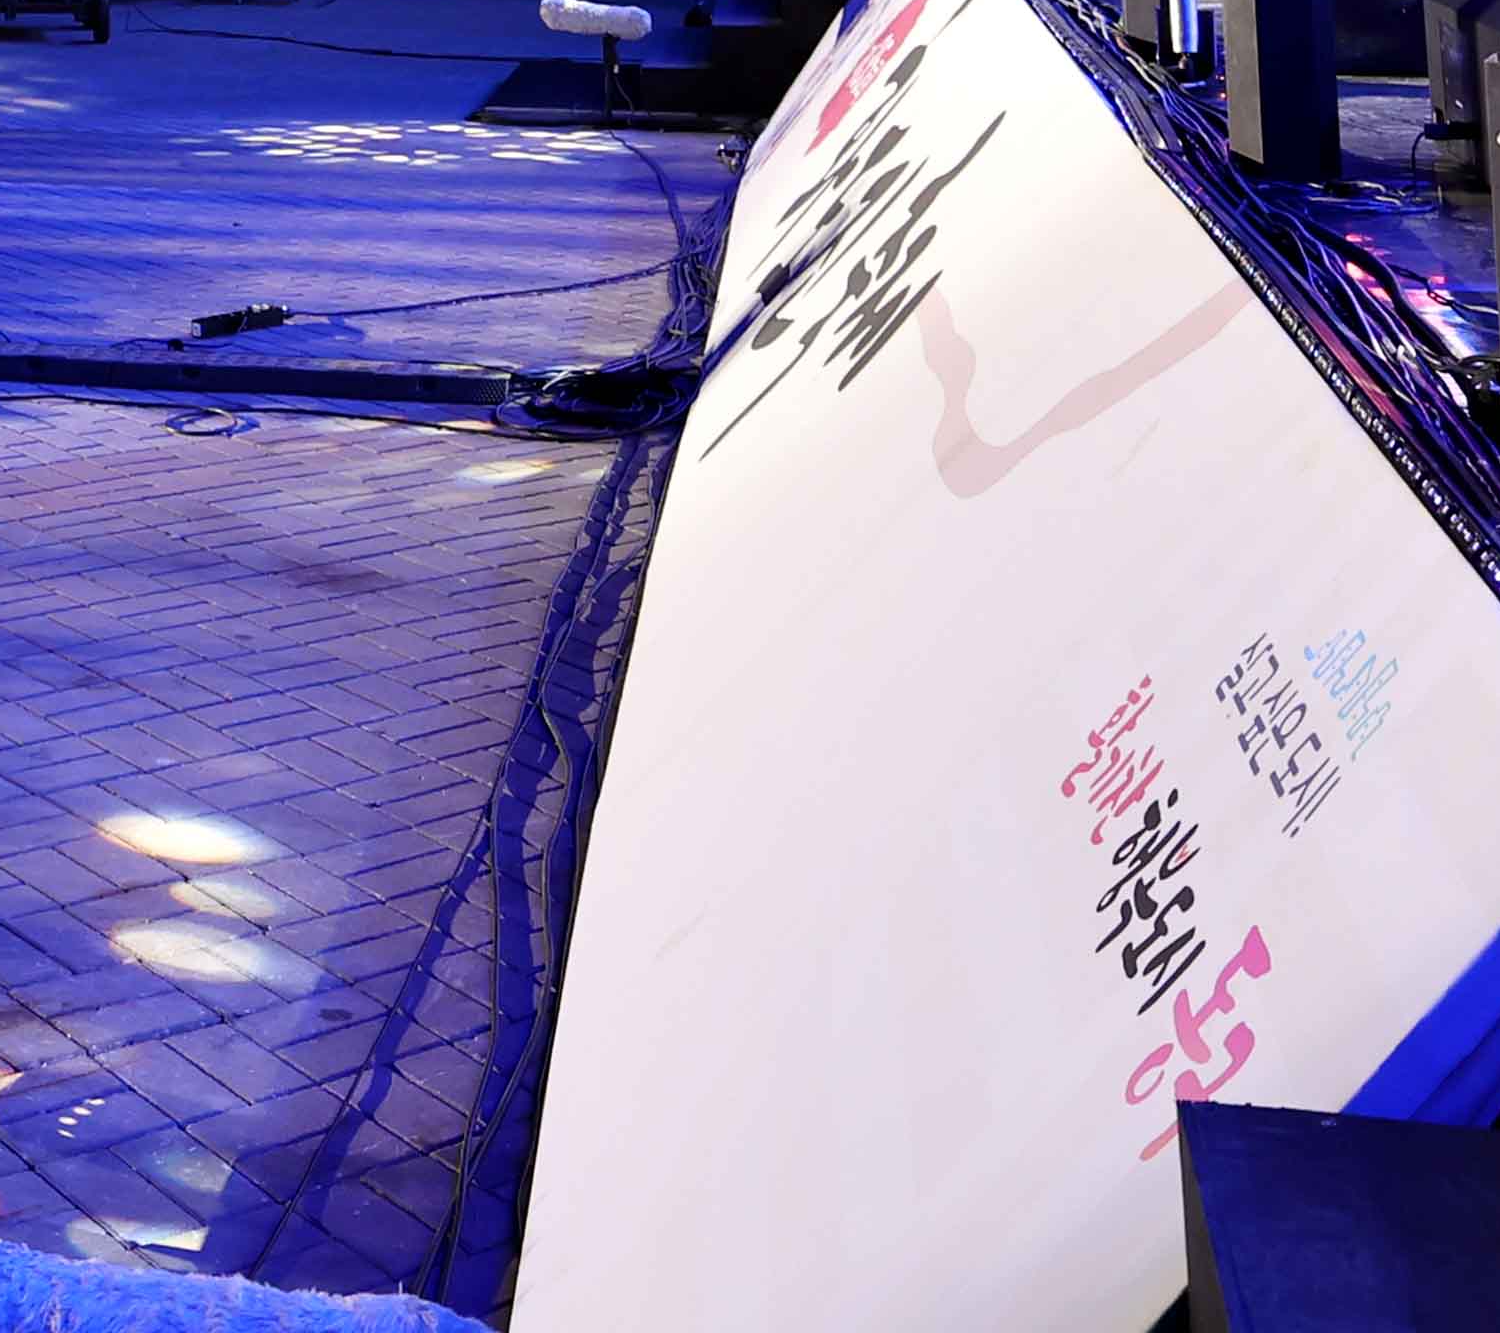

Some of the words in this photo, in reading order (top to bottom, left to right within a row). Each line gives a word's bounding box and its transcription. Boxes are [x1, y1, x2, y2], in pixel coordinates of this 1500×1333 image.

[1215, 632, 1280, 716] 살고
[1062, 675, 1163, 845] 활기찬
[1238, 679, 1308, 776] 싶은
[1269, 733, 1342, 838] 도시!
[1096, 788, 1206, 1015] 행복도시
